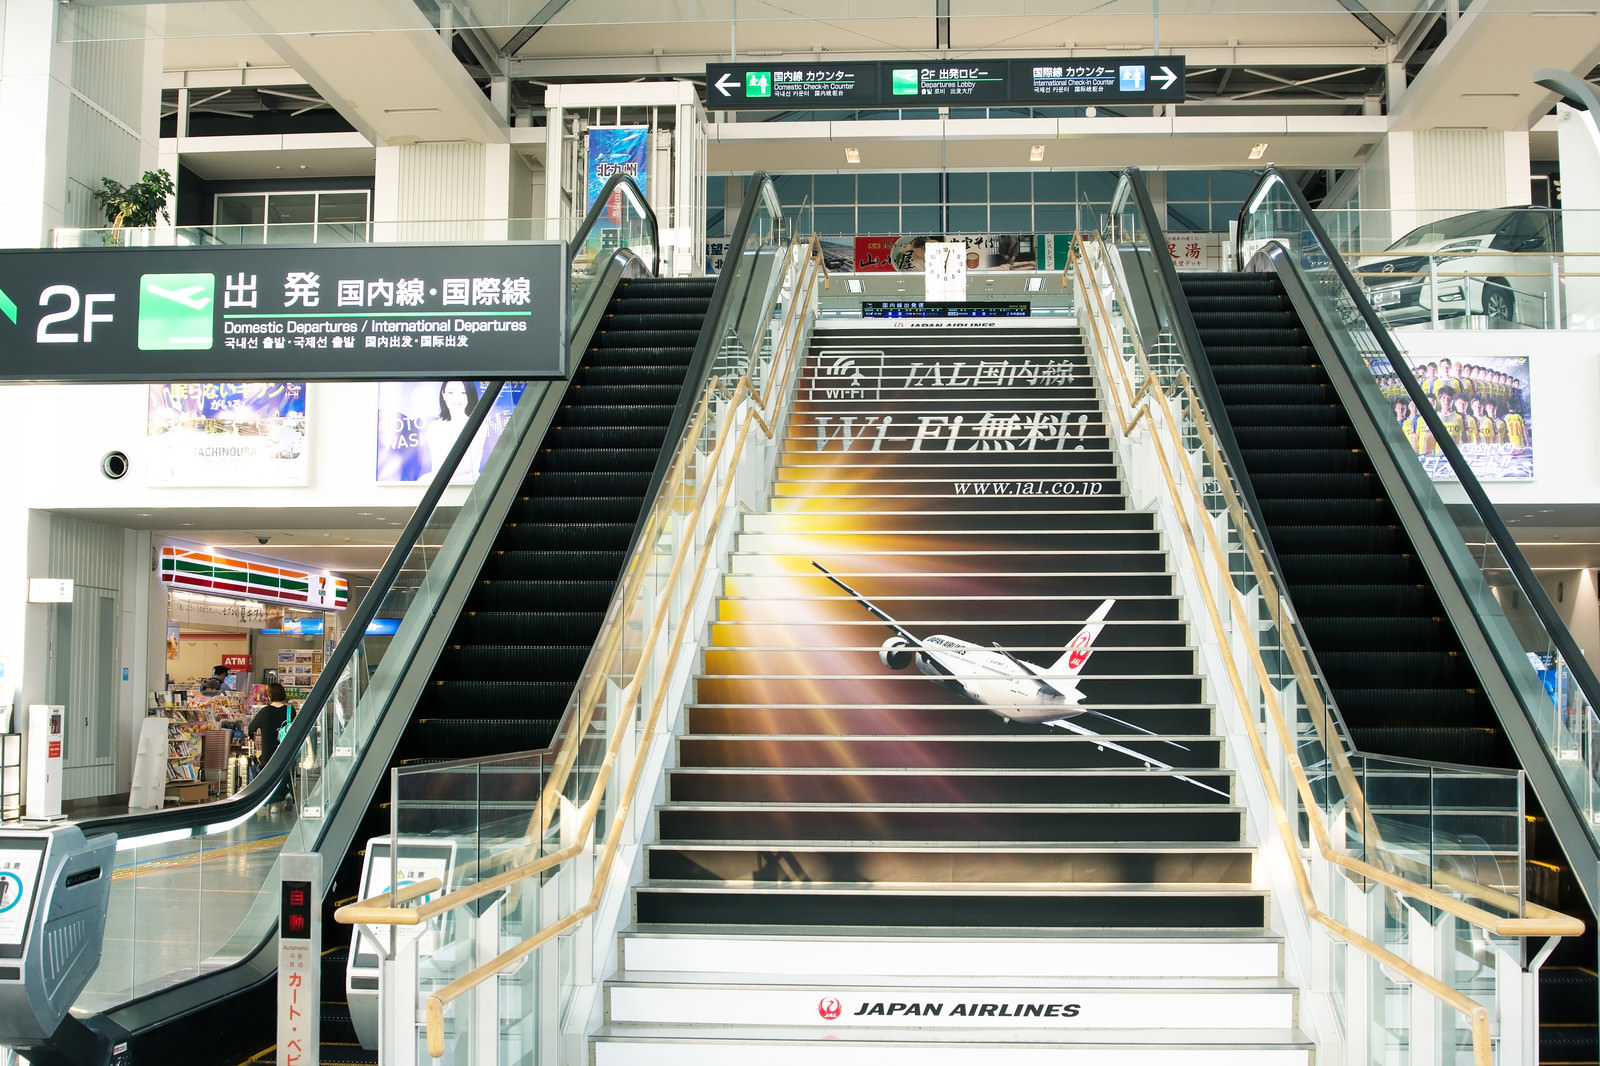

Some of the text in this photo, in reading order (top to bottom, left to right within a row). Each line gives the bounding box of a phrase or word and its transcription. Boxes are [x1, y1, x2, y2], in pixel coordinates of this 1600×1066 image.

[774, 70, 855, 82] 国内線 カウンター
[921, 67, 989, 79] 2F 出発ロビー
[1033, 66, 1115, 78] 国際線 カウンター
[957, 81, 976, 89] Lobby
[596, 162, 638, 177] 北九州
[36, 284, 116, 344] 2F
[223, 318, 527, 335] Domestic Departures / International Departures
[224, 336, 258, 349] 국내선
[331, 335, 356, 349] 출발
[953, 481, 1103, 496] www.jal.co.jp
[225, 657, 246, 666] ATM
[282, 944, 309, 952] Automatic
[853, 1002, 1082, 1018] JAPAN AIRLINES
